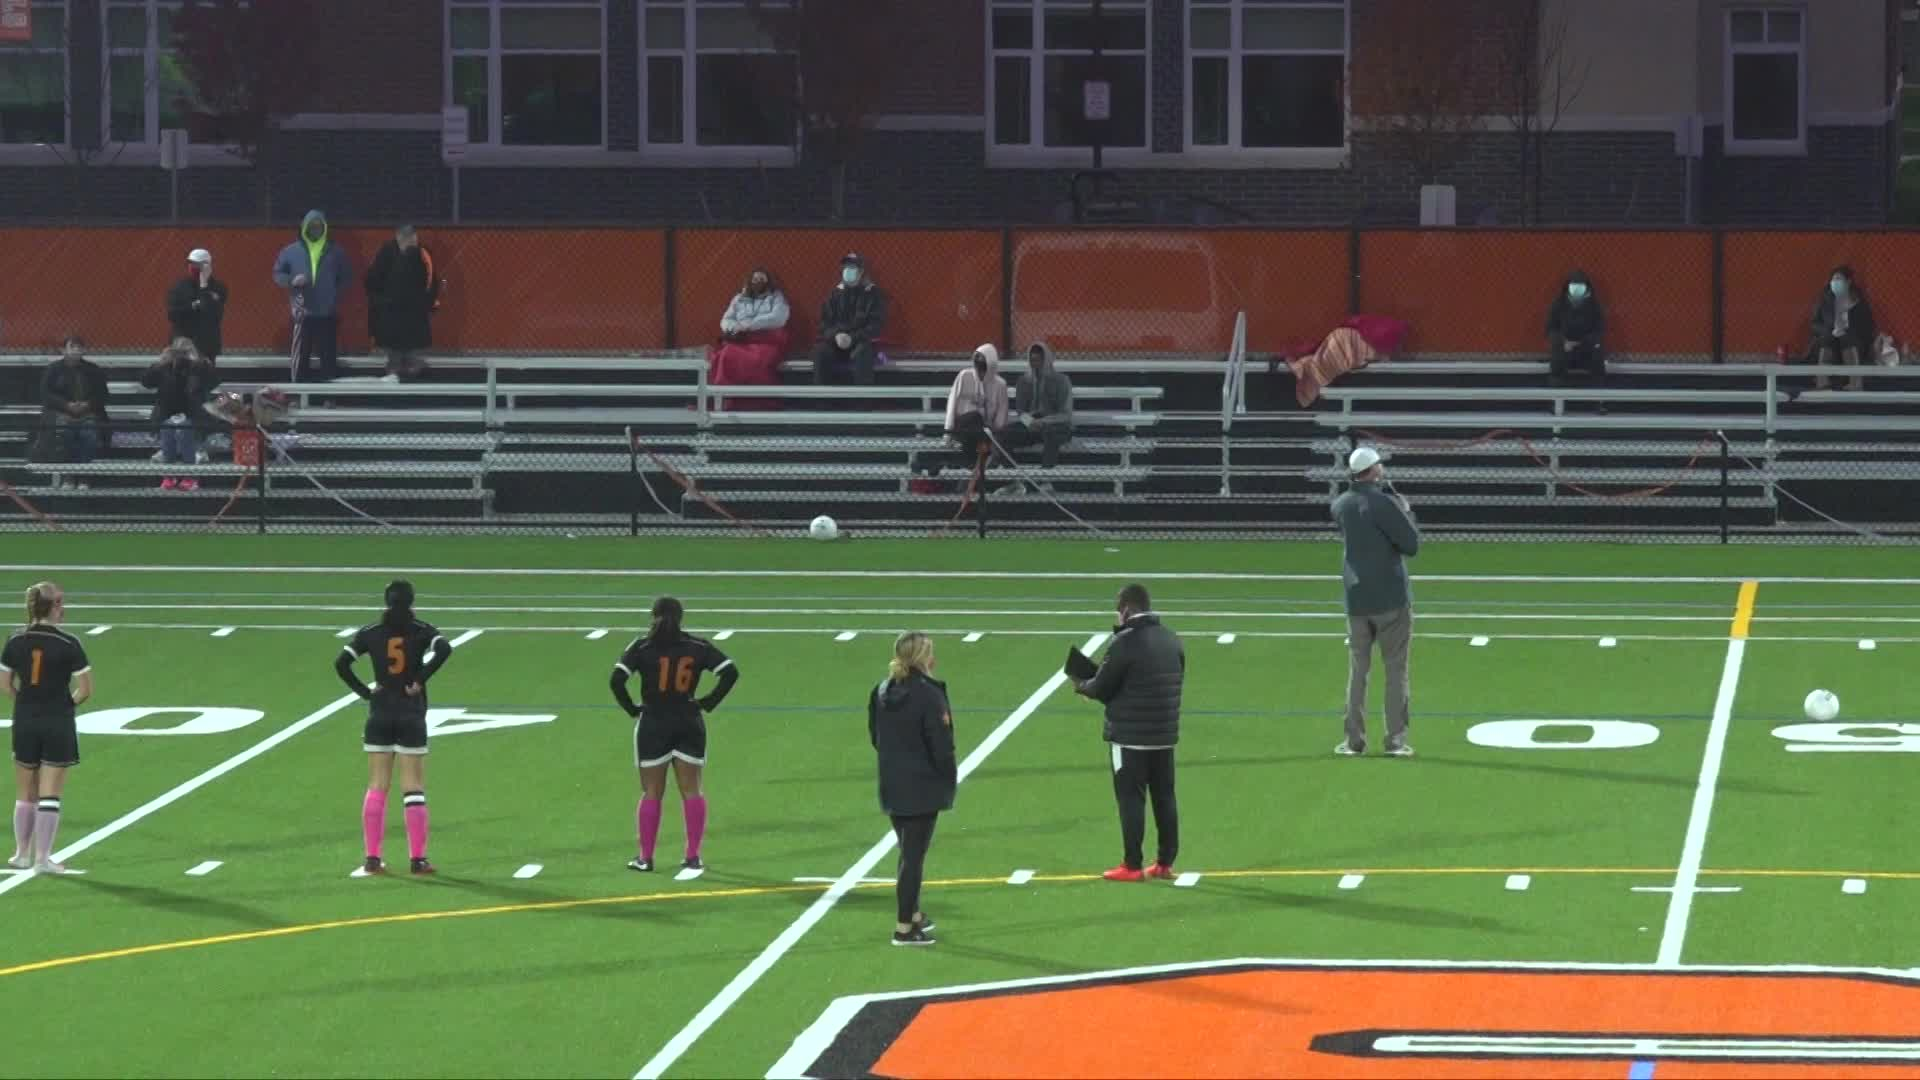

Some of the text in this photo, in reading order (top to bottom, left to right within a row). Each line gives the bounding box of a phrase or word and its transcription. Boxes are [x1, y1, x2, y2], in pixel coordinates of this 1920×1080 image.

[30, 646, 45, 686] 1
[385, 635, 407, 675] 5
[657, 655, 696, 693] 16
